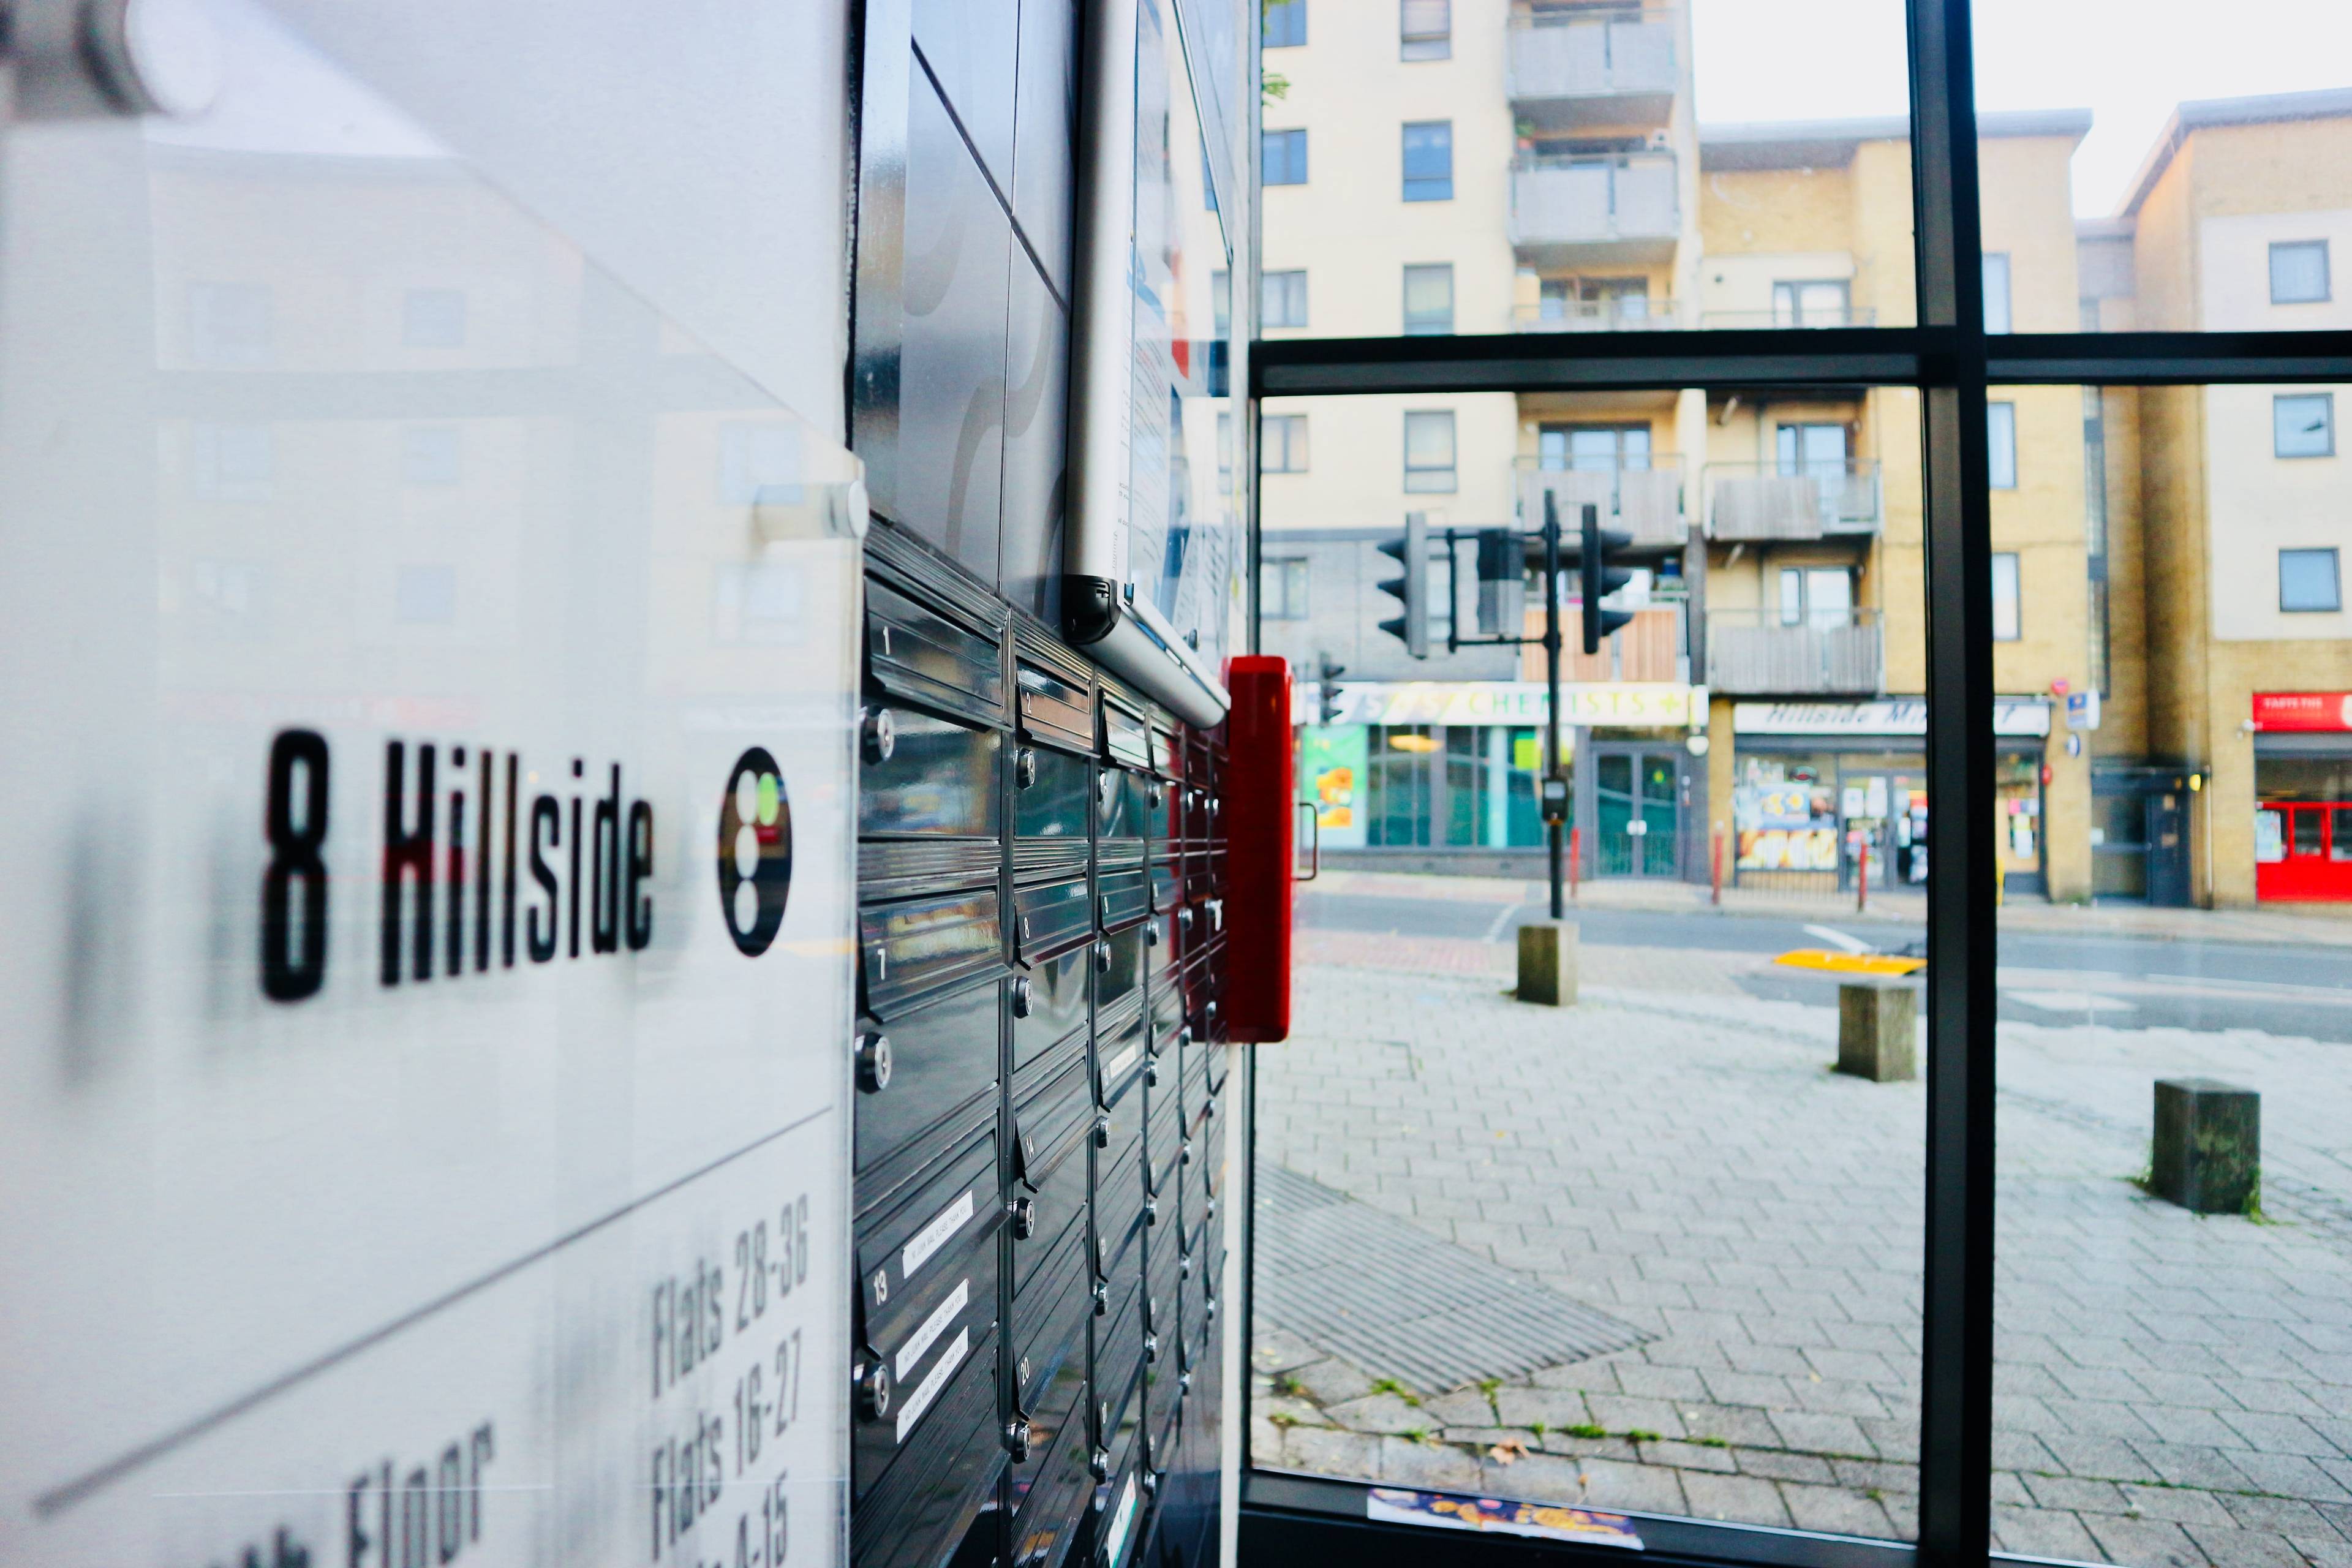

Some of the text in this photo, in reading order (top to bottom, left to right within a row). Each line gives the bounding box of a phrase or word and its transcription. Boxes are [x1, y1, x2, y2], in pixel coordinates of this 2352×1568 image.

[882, 626, 891, 655] 1
[1026, 692, 1032, 714] 2
[262, 726, 653, 1005] 8 Hillside
[1023, 916, 1030, 939] 8
[1026, 1135, 1036, 1159] 14
[651, 1192, 809, 1403] Flats 28-36
[874, 1270, 888, 1306] 13
[1021, 1357, 1030, 1385] 20
[651, 1411, 722, 1565] Flats
[735, 1326, 801, 1478] 16-27
[346, 1418, 495, 1568] Floor
